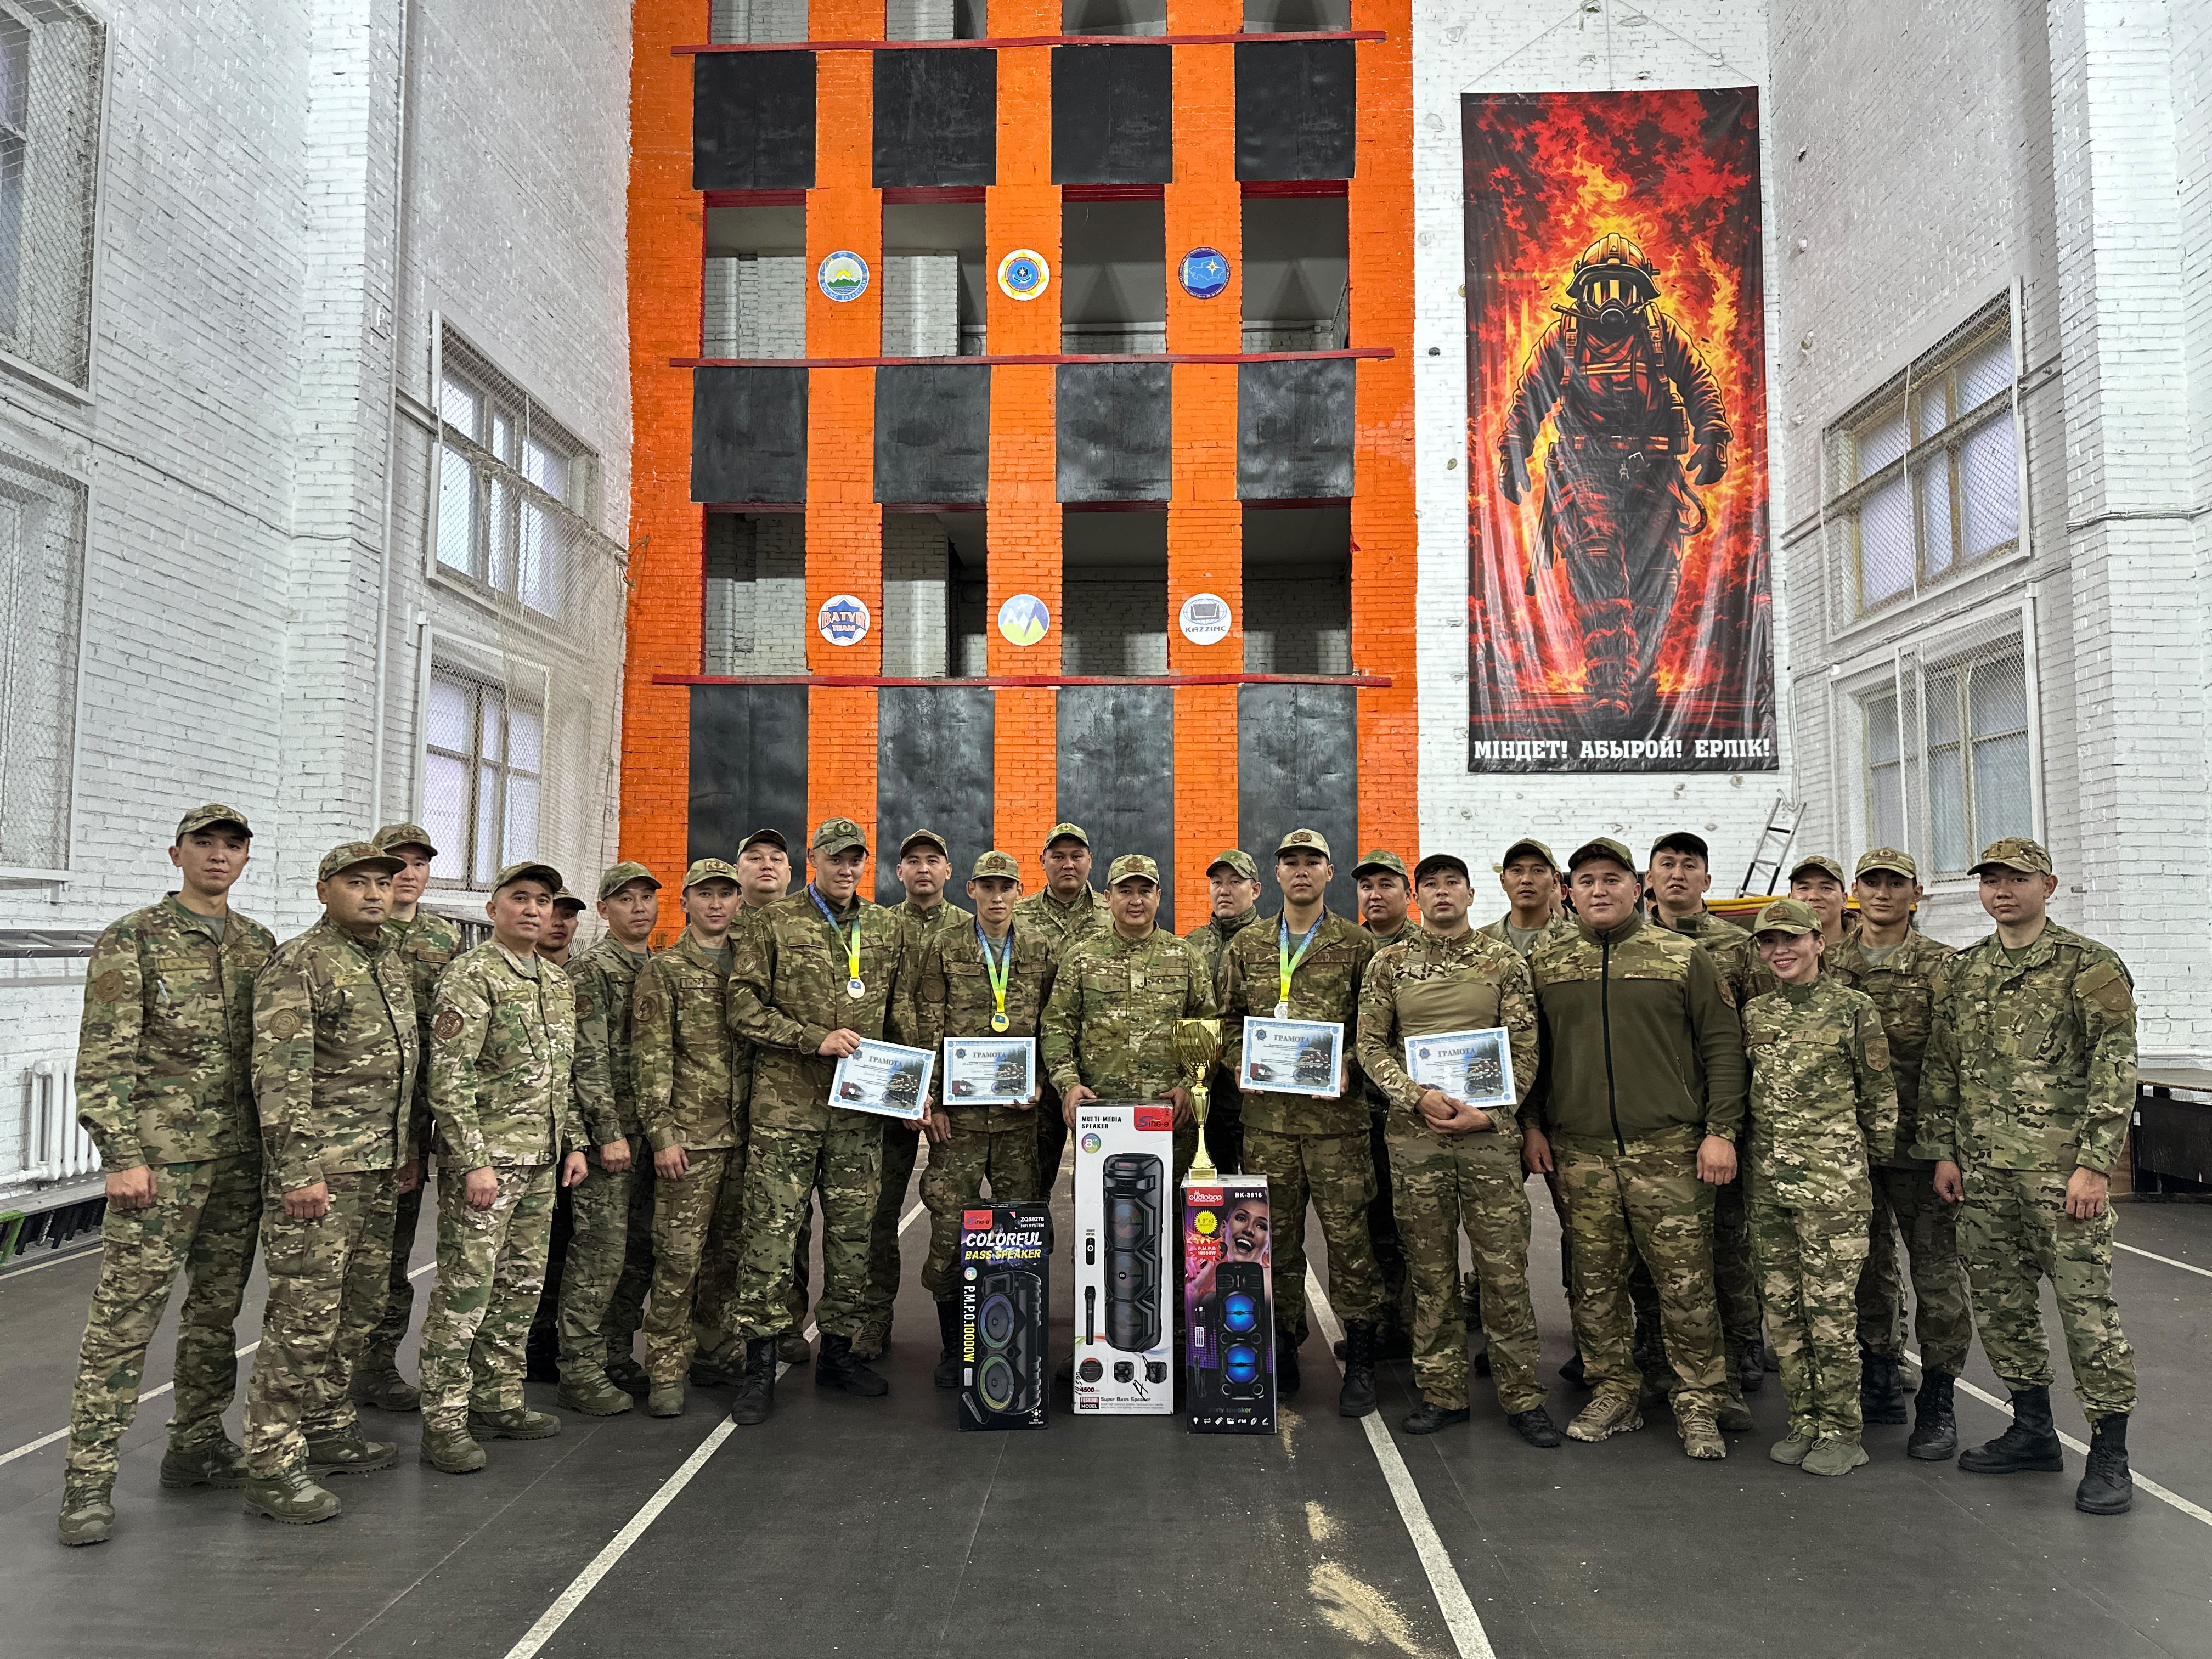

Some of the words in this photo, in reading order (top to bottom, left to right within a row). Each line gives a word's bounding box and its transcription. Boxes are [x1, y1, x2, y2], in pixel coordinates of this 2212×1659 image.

[821, 611, 866, 631] BATYR
[1474, 740, 1568, 761] МІНДЕТ!
[1579, 736, 1683, 758] АБЫРОЙ!
[1695, 738, 1770, 758] ЕРЛІК!
[1438, 1047, 1476, 1057] ГРАМОТА
[868, 1056, 904, 1068] ГРАМОТА
[966, 1232, 1042, 1247] COLORFUL
[964, 1250, 992, 1260] BASS
[995, 1249, 1042, 1260] SPEAKER
